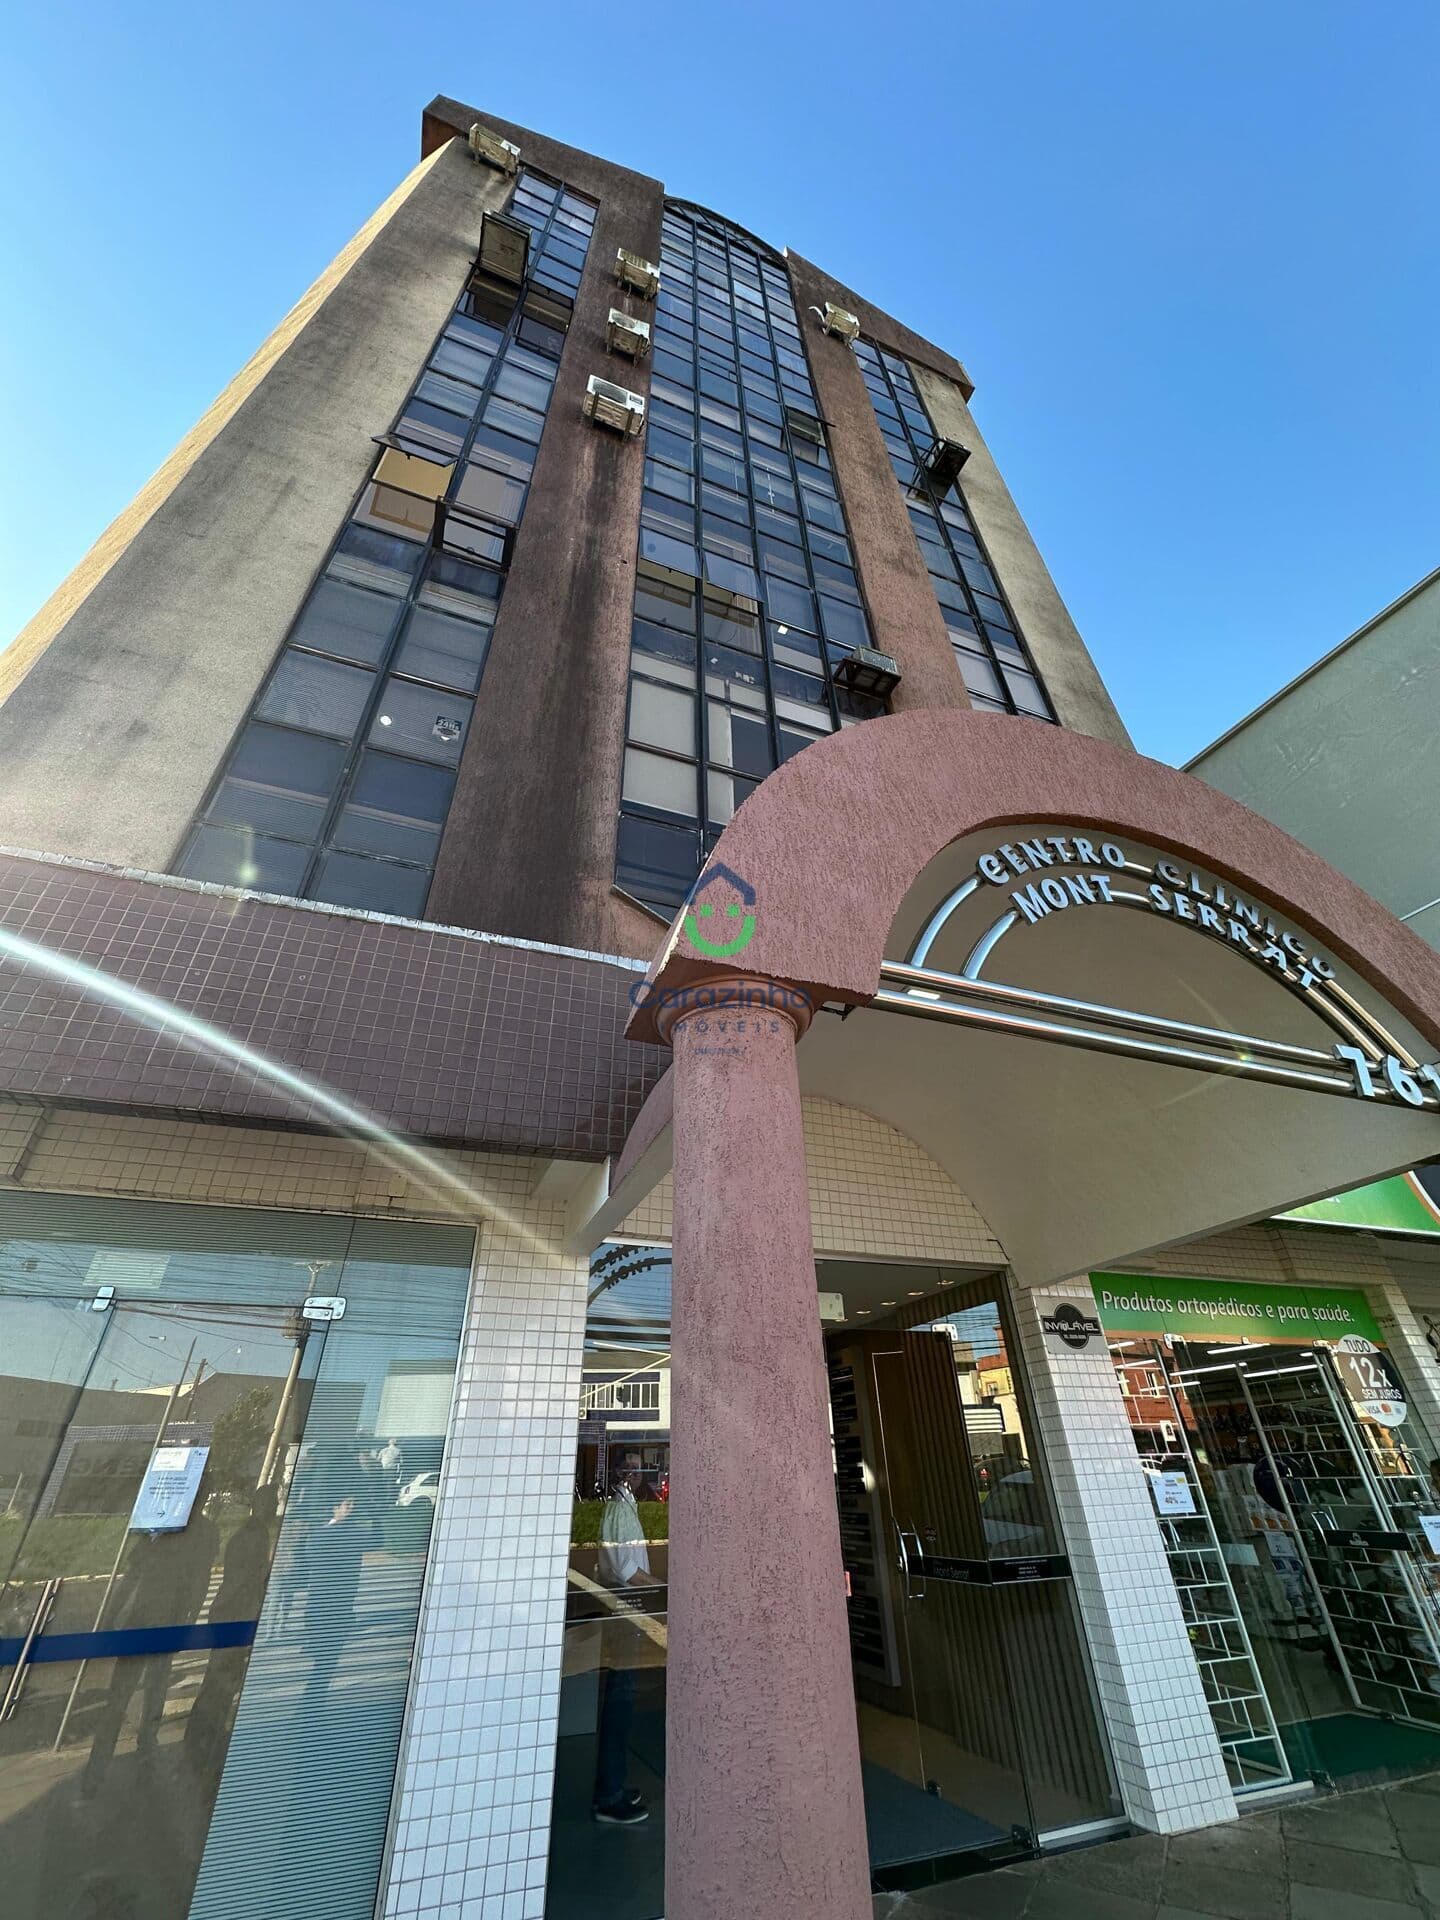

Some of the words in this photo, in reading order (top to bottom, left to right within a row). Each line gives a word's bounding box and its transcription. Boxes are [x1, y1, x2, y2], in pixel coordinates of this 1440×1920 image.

[977, 837, 1126, 884] CENTRO
[1154, 859, 1336, 979] CLINICO
[1009, 874, 1114, 924] MONT
[1148, 884, 1322, 990] SERRAT
[1101, 1290, 1174, 1313] Produtos
[1177, 1296, 1262, 1321] ortopédicos
[1265, 1304, 1274, 1318] e
[1277, 1304, 1310, 1324] para
[1312, 1303, 1355, 1322] saúde.
[1344, 1340, 1370, 1353] TUDO
[1362, 1388, 1379, 1400] SEM
[1379, 1388, 1402, 1400] JUROS
